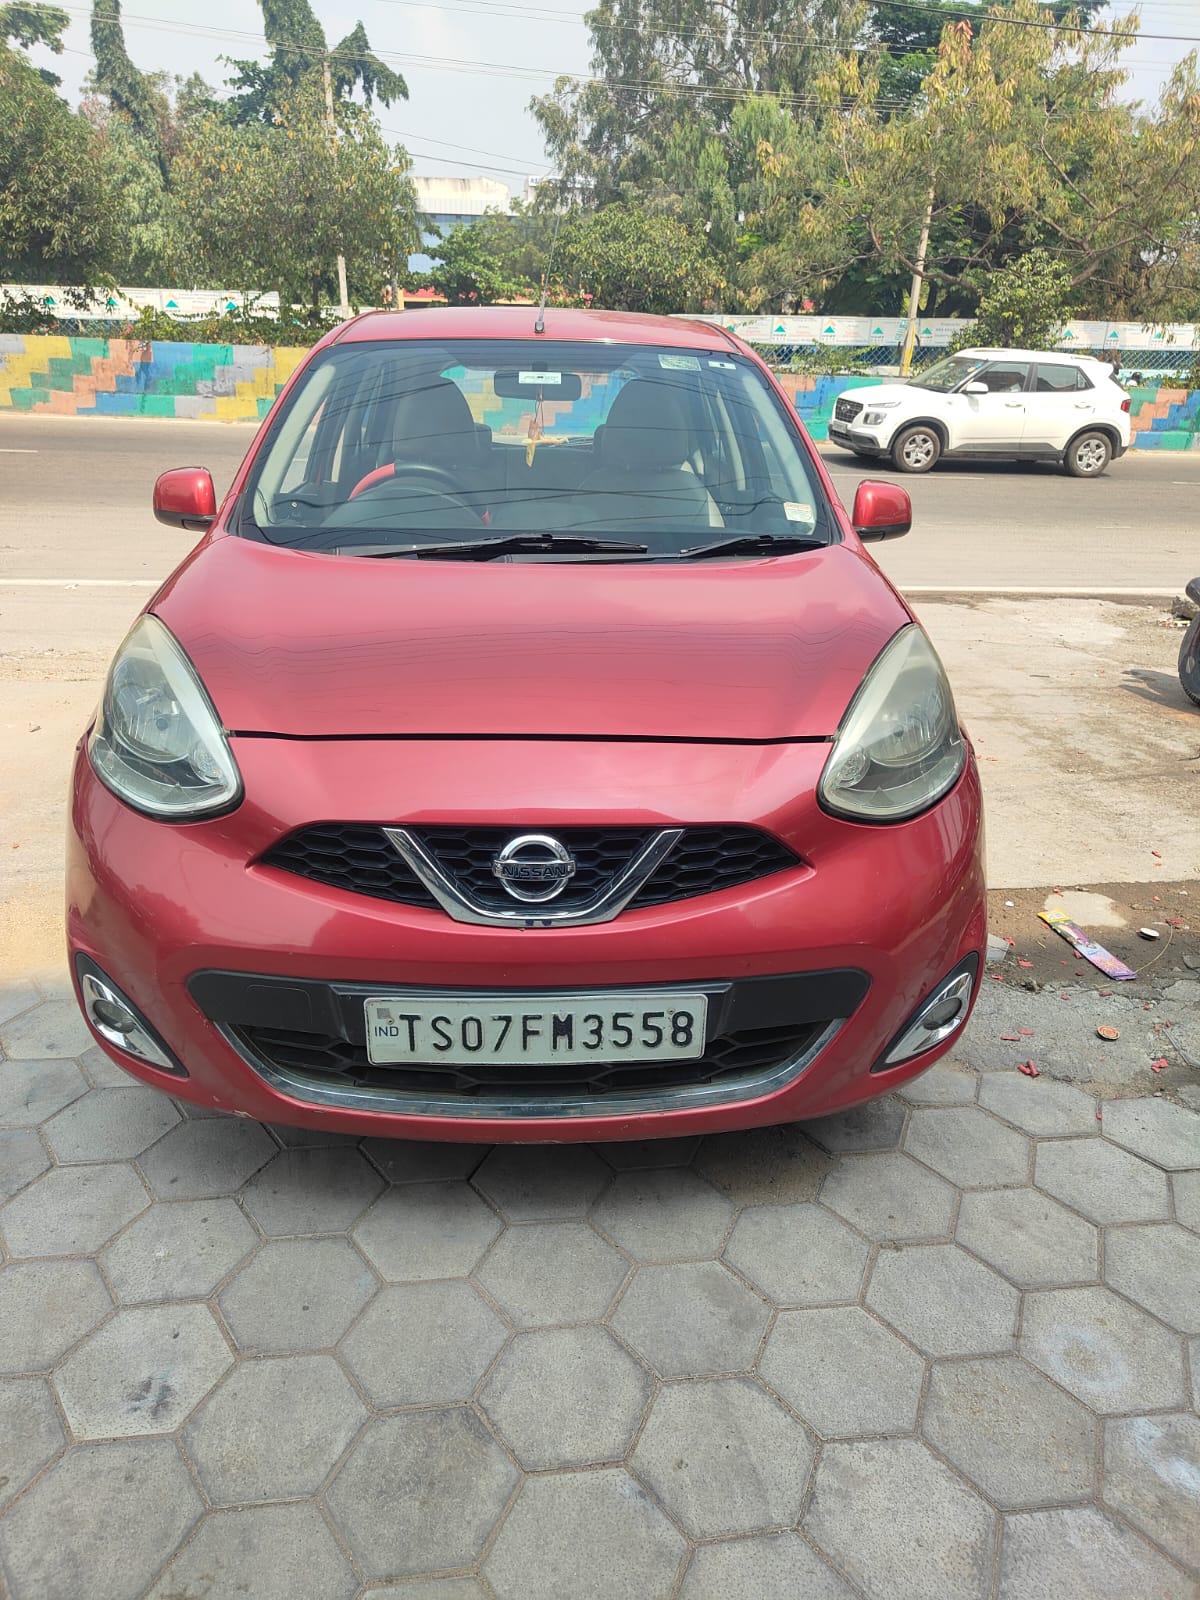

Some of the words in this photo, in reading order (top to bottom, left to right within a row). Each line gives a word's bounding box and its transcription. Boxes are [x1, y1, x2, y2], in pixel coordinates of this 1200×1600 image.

[502, 865, 566, 877] NISSAN
[374, 1026, 399, 1037] IND
[399, 1010, 694, 1052] TS07FM3558
